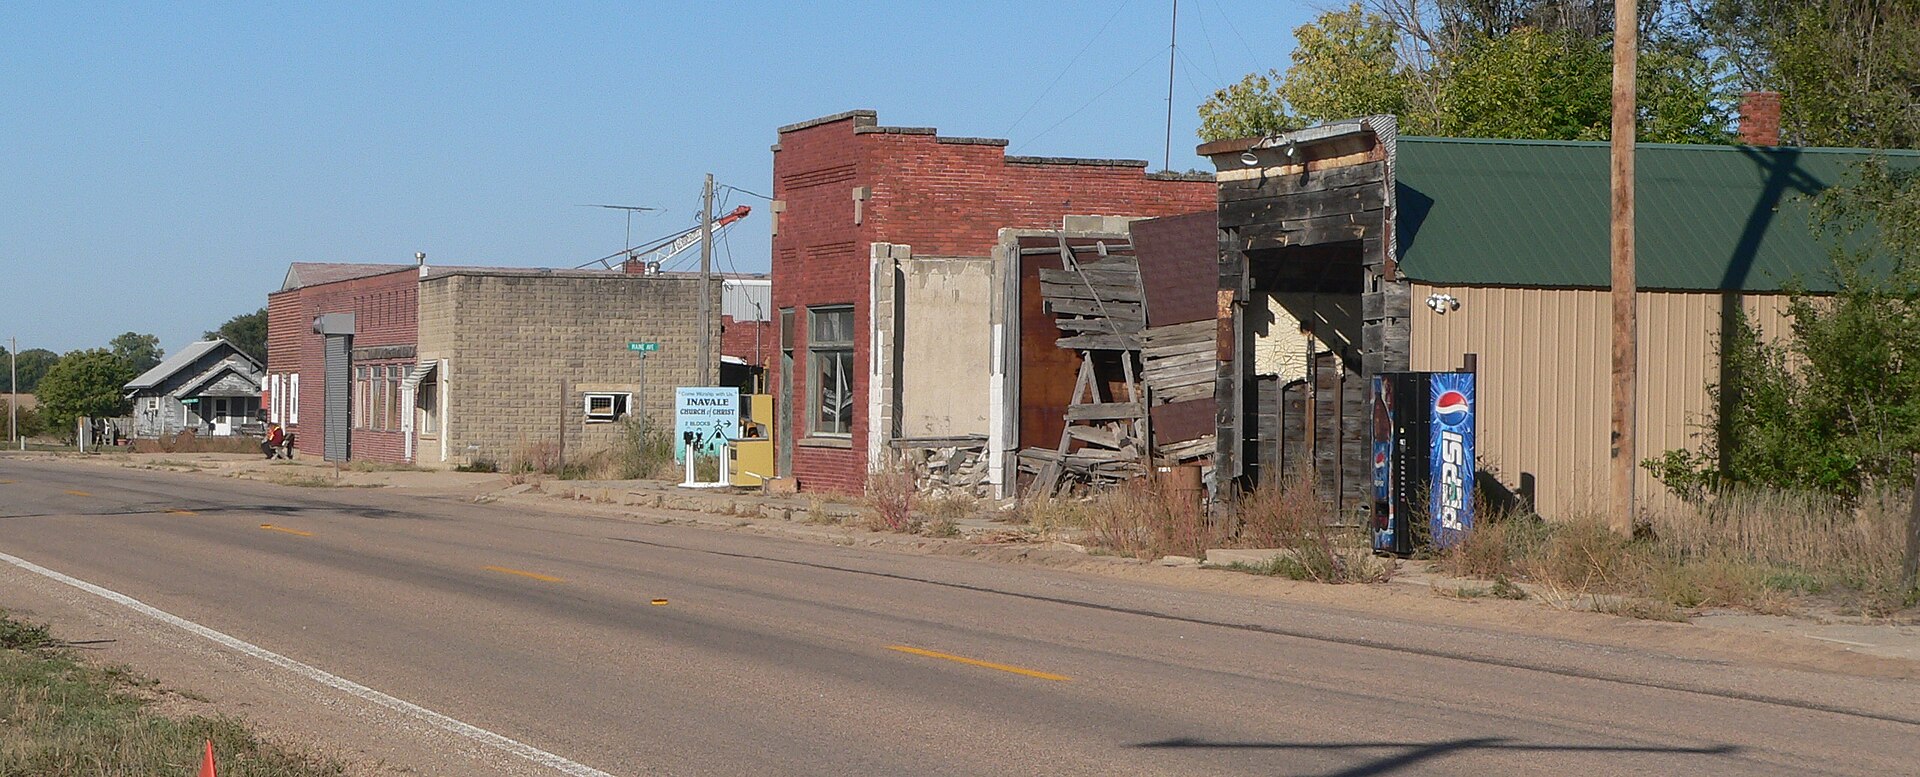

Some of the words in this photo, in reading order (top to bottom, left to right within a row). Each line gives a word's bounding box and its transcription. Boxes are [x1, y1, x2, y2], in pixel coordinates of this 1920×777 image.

[687, 398, 729, 406] INAVALE
[706, 407, 712, 418] of
[1442, 430, 1463, 531] PEPSI
